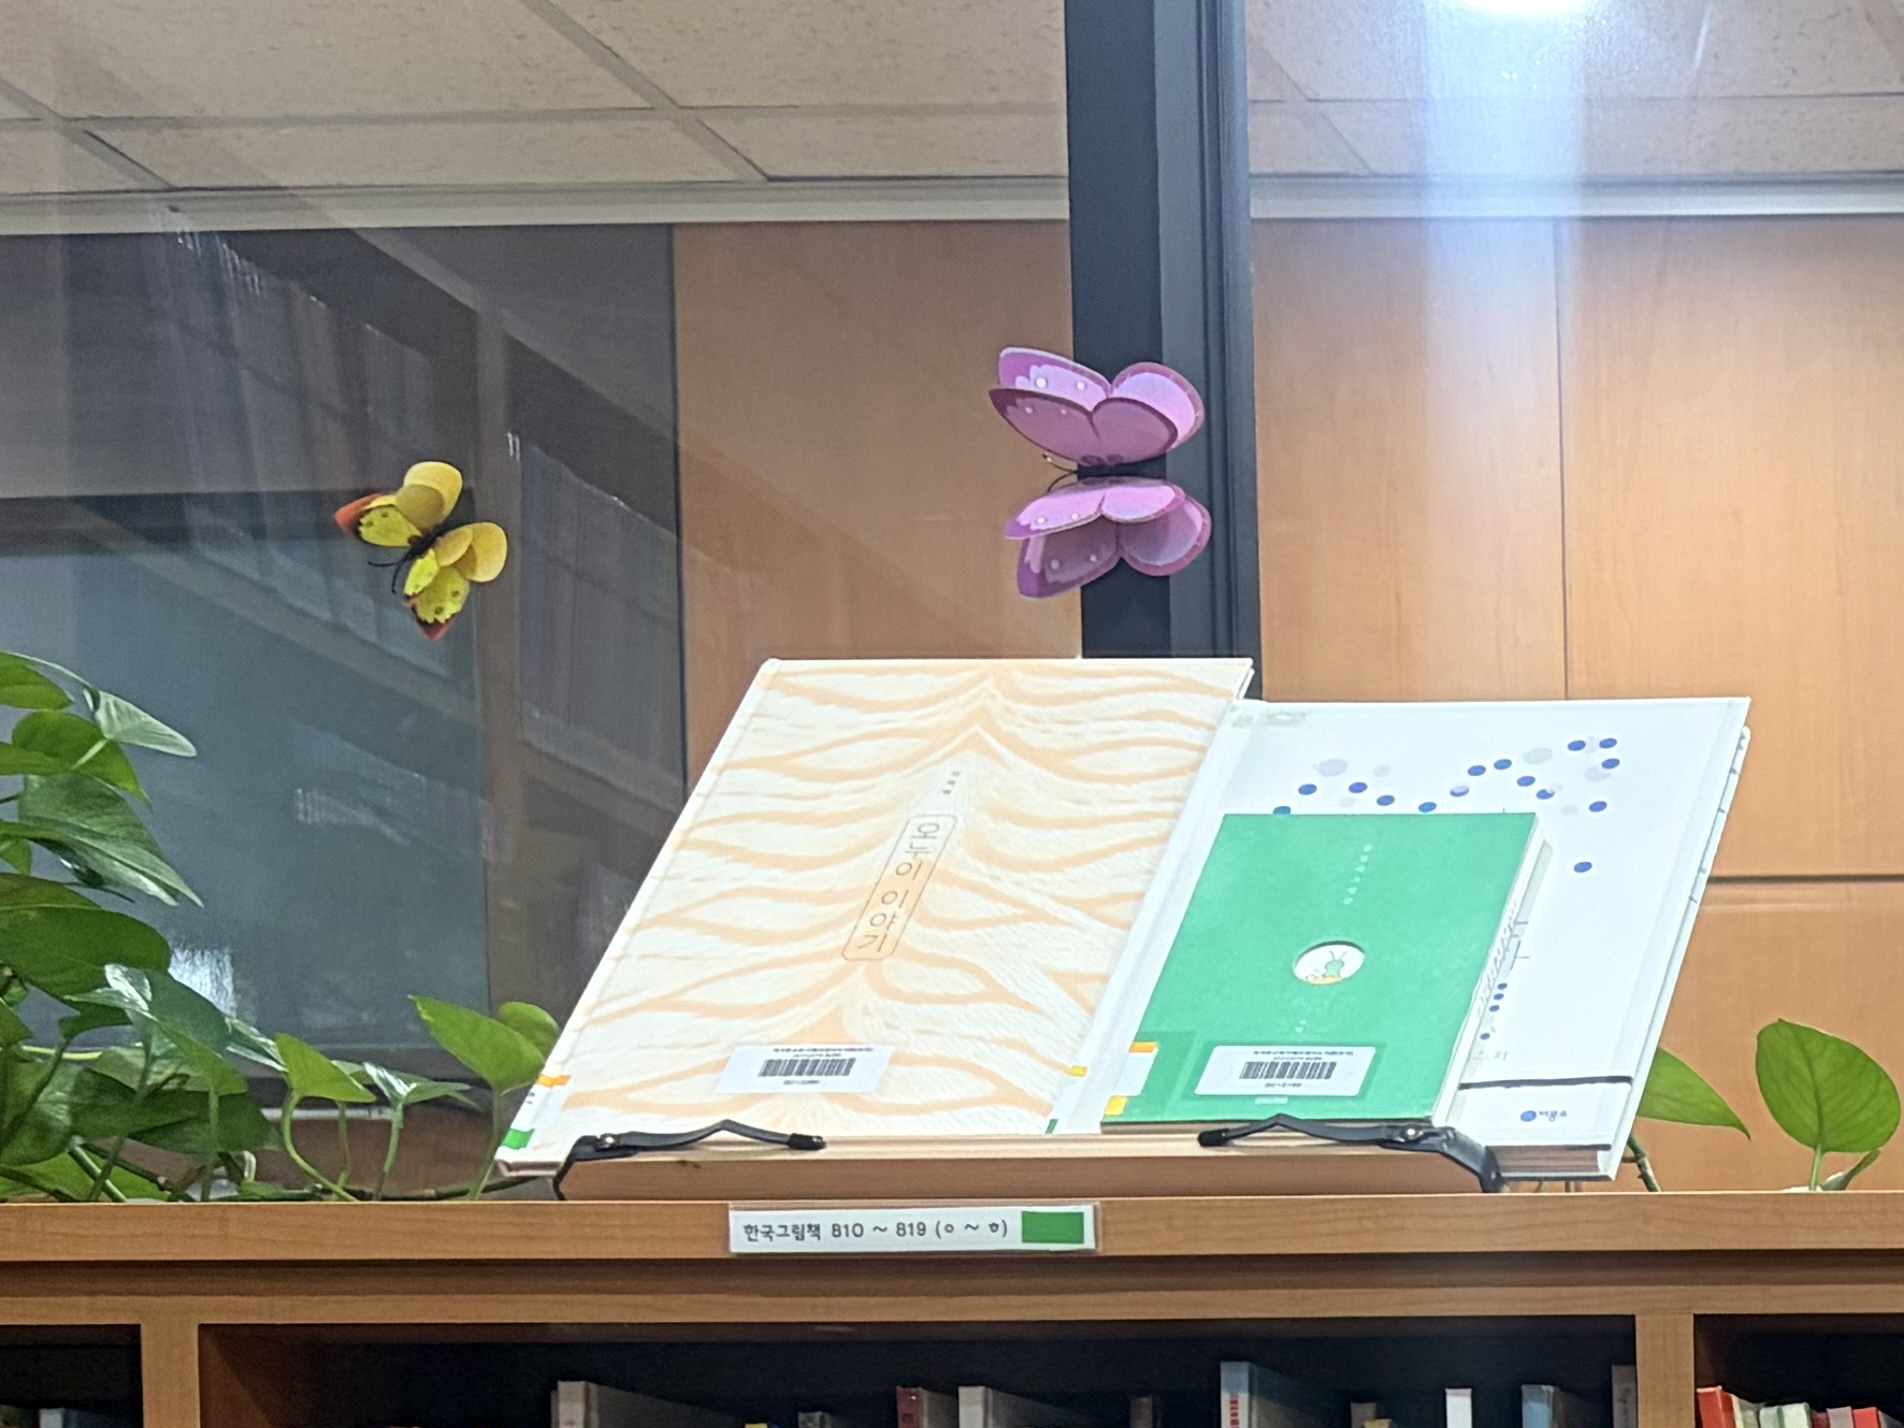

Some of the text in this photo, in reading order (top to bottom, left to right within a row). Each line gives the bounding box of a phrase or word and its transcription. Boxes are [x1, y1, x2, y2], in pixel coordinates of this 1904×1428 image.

[856, 889, 909, 954] 이야기
[742, 1222, 822, 1242] 한국그림책
[831, 1222, 865, 1239] 810
[895, 1221, 927, 1238] 819
